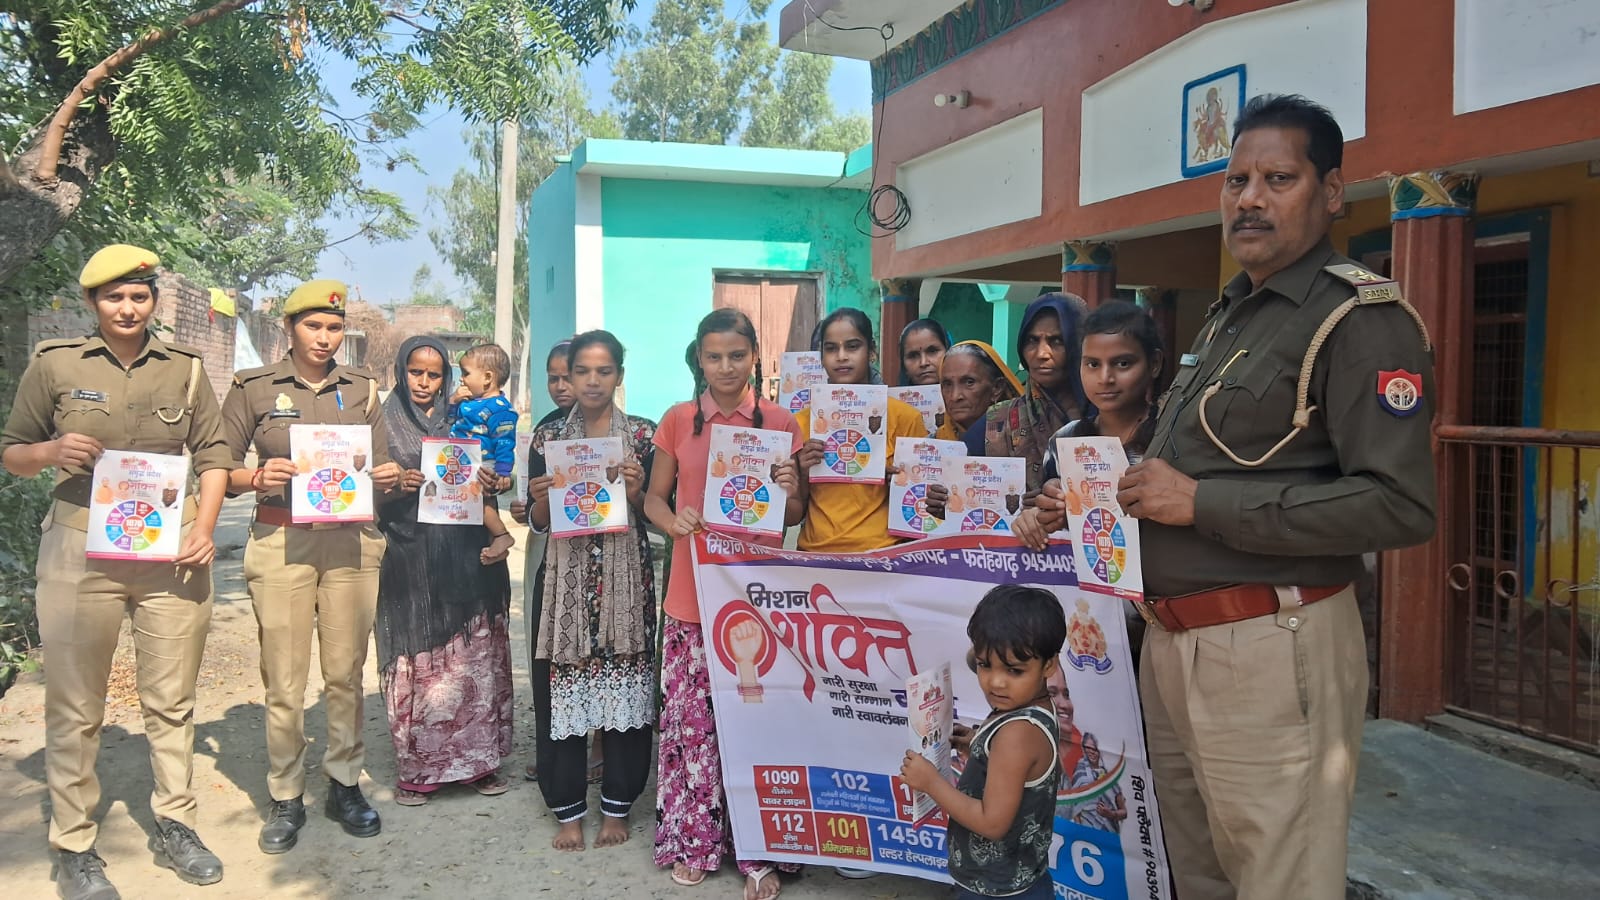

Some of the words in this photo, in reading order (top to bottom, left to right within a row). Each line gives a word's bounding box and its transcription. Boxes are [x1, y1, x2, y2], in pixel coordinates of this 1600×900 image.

[706, 533, 745, 555] मिशन
[897, 549, 947, 566] जनपद
[961, 542, 1019, 578] फतेहगढ़
[1022, 552, 1078, 573] 9454403
[746, 582, 810, 609] मिशन
[770, 583, 918, 704] शक्ति
[822, 676, 843, 689] नारी
[848, 679, 878, 694] सुरक्षा
[829, 691, 851, 703] नारी
[853, 693, 892, 707] सम्मान
[832, 705, 854, 719] नारी
[856, 710, 909, 727] स्वावलंबन
[762, 770, 799, 785] 1090
[831, 771, 871, 792] 102
[1131, 775, 1146, 802] शिव
[771, 812, 806, 833] 112
[827, 817, 860, 840] 101
[877, 823, 947, 851] 14567
[878, 847, 904, 861] एल्डर
[1048, 832, 1105, 886] 76
